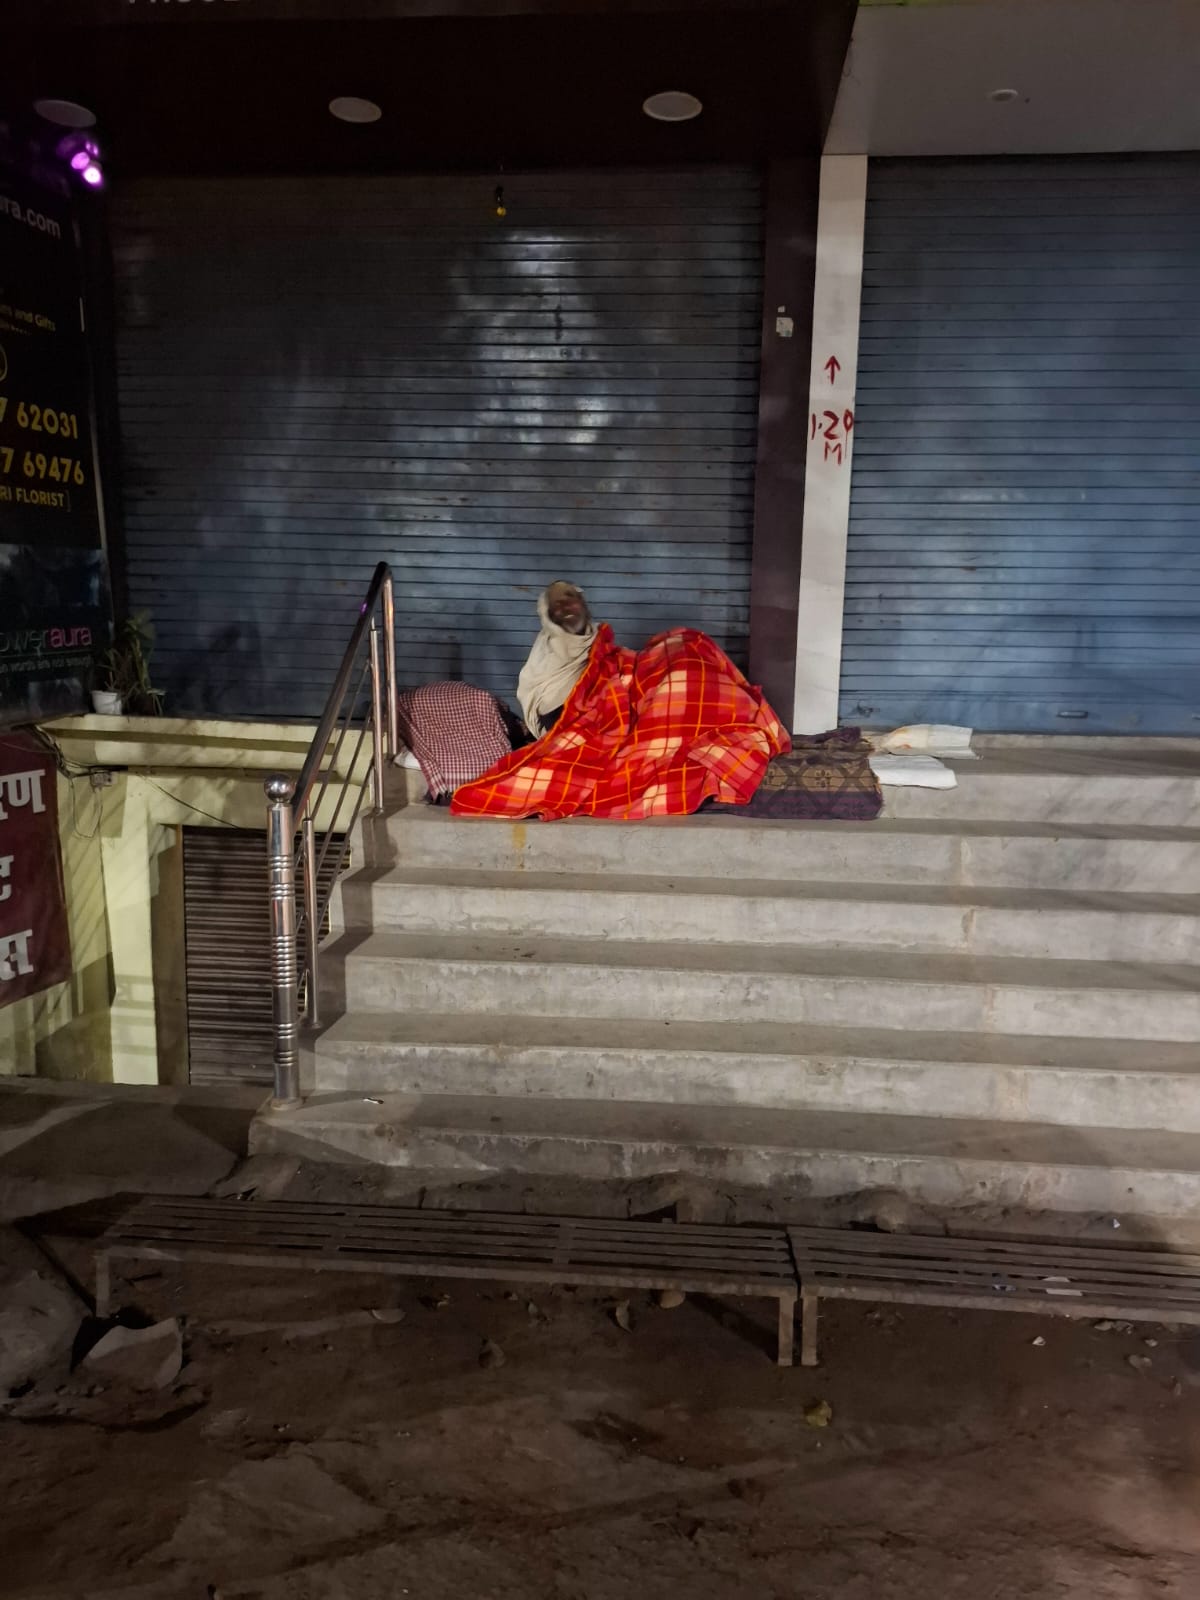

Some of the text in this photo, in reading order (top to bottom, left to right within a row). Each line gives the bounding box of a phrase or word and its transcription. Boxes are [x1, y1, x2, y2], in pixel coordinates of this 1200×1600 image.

[16, 402, 78, 439] 62031
[23, 452, 84, 485] 69476
[824, 441, 842, 465] M
